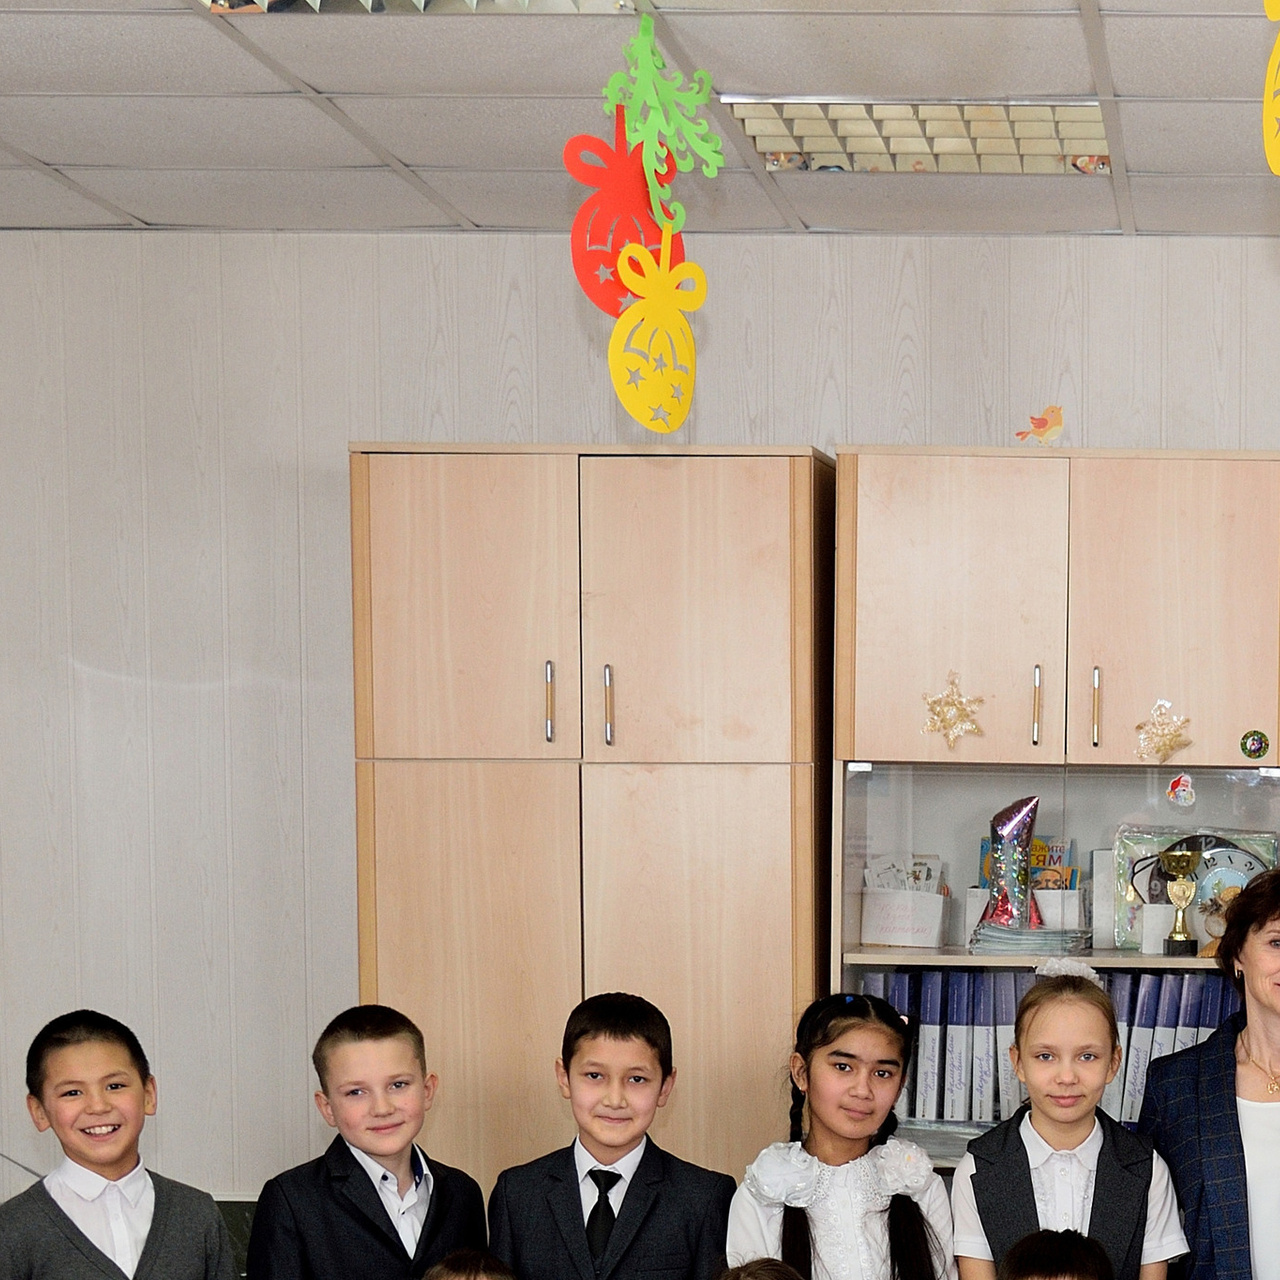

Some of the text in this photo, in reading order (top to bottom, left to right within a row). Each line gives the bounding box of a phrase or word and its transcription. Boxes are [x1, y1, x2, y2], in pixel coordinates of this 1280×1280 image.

[1204, 857, 1218, 870] 12
[1228, 855, 1233, 865] 1
[1245, 861, 1255, 872] 2
[1150, 881, 1162, 893] 9
